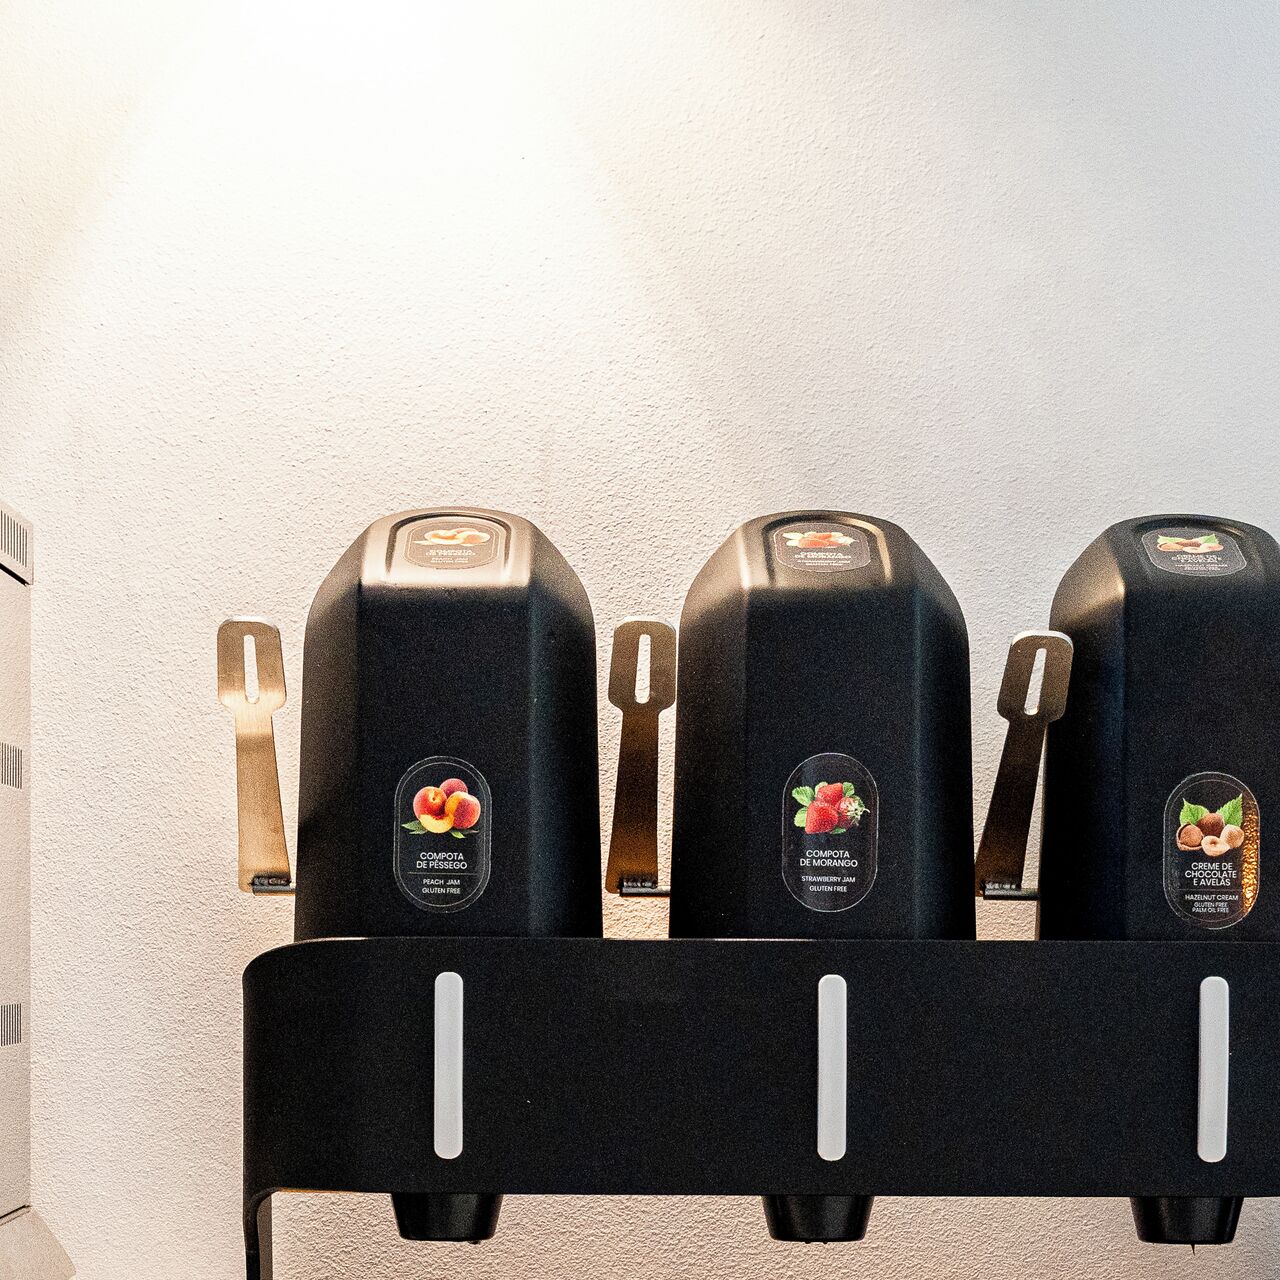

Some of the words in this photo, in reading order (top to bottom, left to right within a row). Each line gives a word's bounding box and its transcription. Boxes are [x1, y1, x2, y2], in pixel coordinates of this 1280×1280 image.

[420, 852, 464, 860] COMPOTA
[806, 849, 850, 859] COMPOTA
[416, 861, 428, 869] DE
[429, 860, 468, 870] PÊSSEGO
[800, 858, 811, 867] DE
[812, 859, 858, 868] MORANGO
[1191, 862, 1220, 870] CREME
[1221, 862, 1233, 870] DE
[1184, 870, 1237, 879] CHOCOLATE
[446, 878, 461, 886] JAM
[801, 875, 842, 883] STRAWBERRY
[1193, 878, 1198, 886] E
[446, 887, 461, 895] FREE
